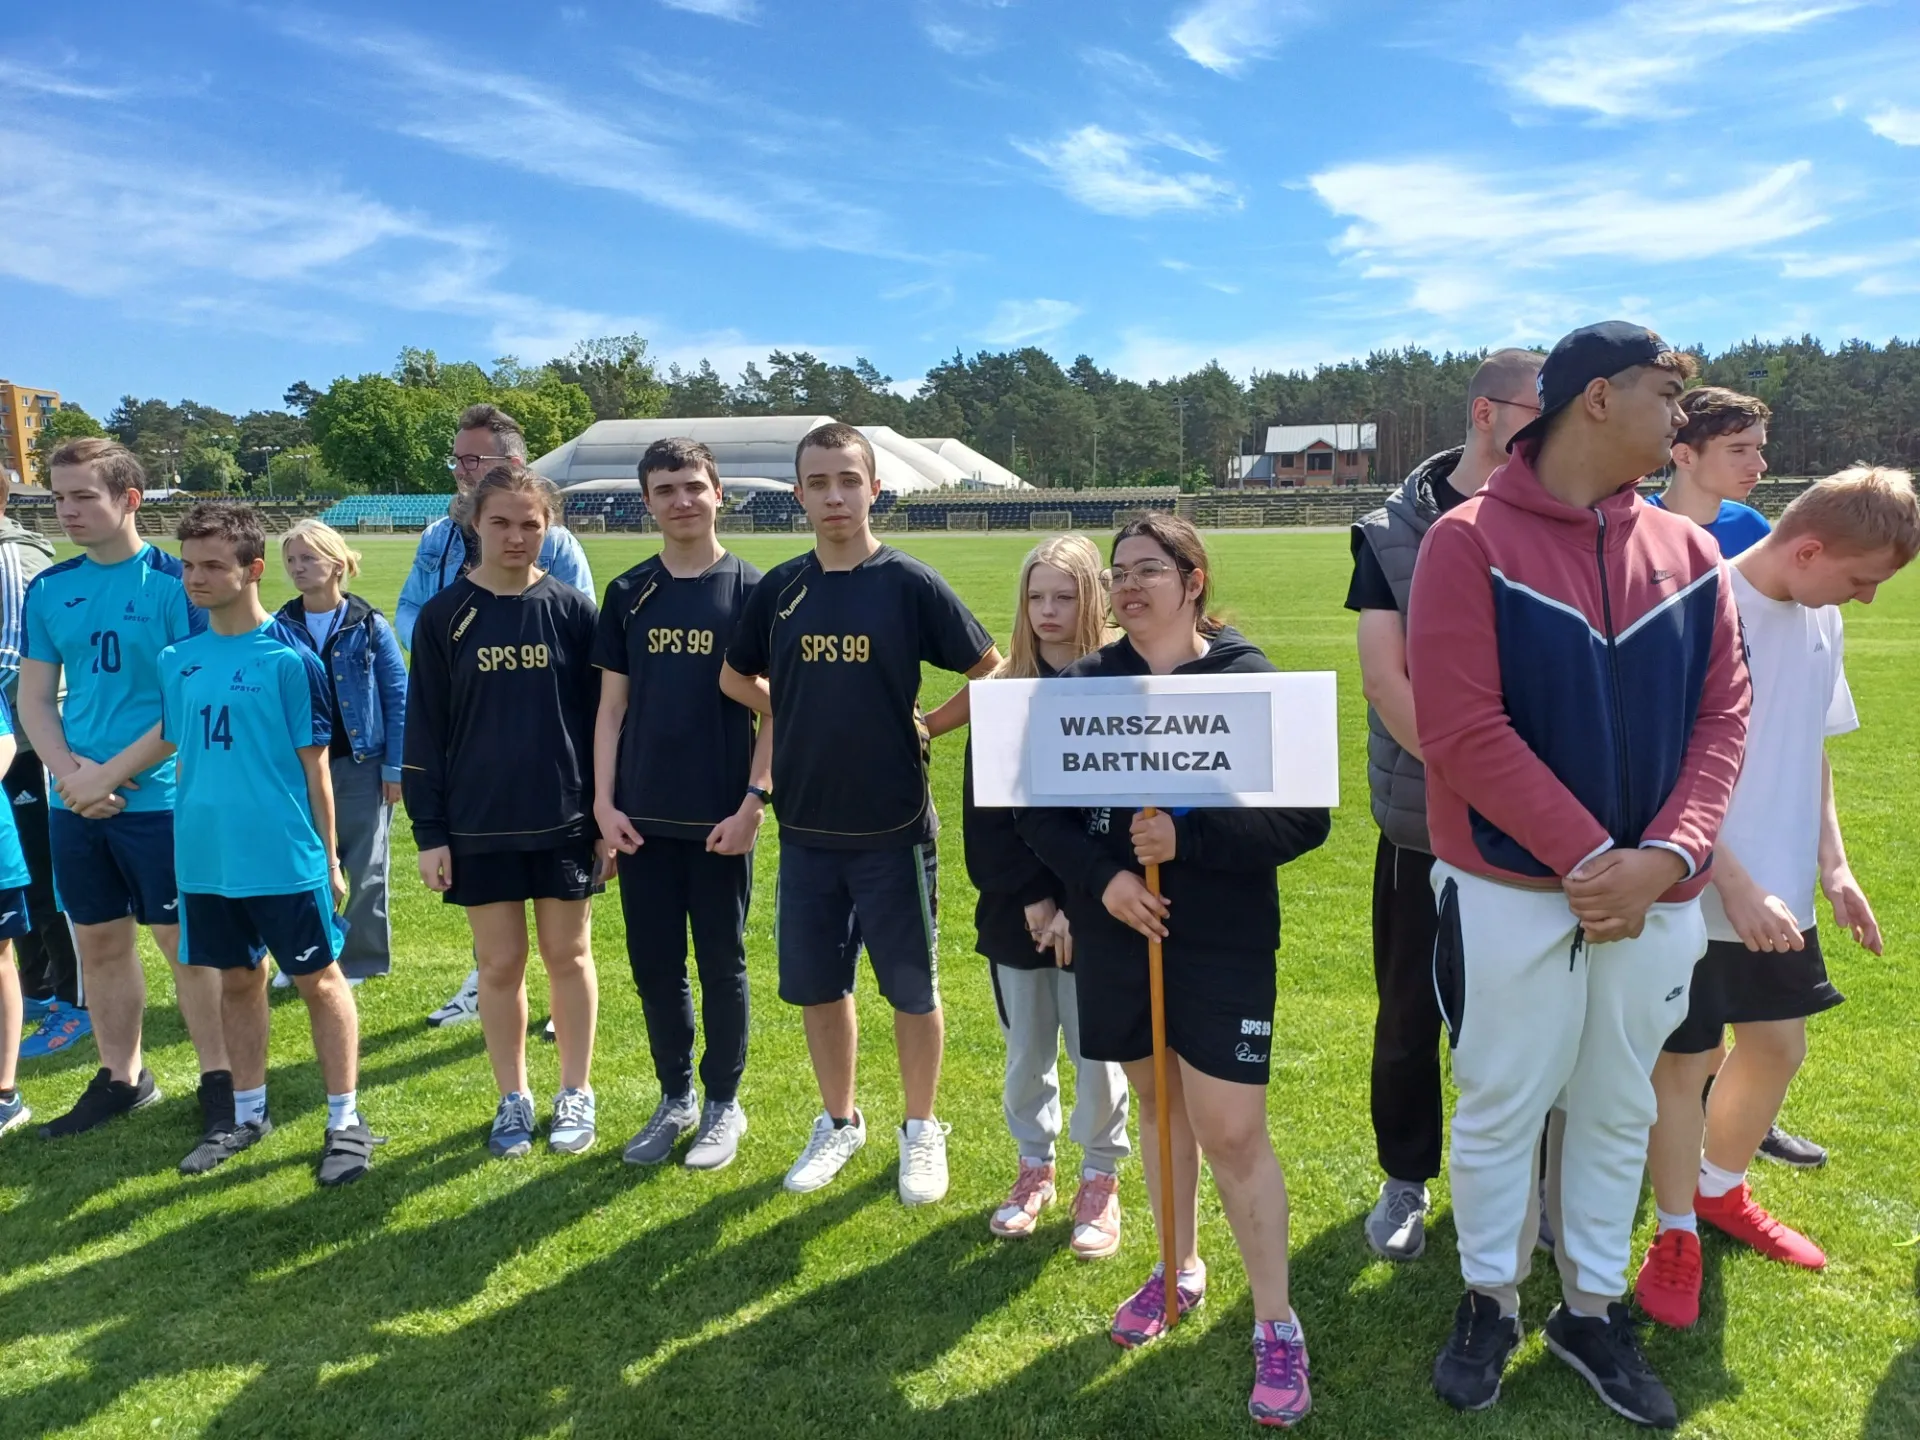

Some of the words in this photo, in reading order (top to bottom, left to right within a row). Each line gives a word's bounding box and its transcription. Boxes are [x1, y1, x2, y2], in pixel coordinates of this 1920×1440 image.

[779, 585, 808, 620] hummel
[90, 630, 121, 673] 20
[648, 628, 684, 654] SPS
[687, 629, 714, 655] 99
[801, 634, 838, 663] SPS
[842, 634, 870, 663] 99
[477, 645, 518, 672] SPS
[520, 643, 549, 669] 99
[200, 704, 233, 751] 14
[1060, 715, 1231, 736] WARSZAWA
[1062, 751, 1232, 772] BARTNICZA
[1241, 1019, 1262, 1036] SPS
